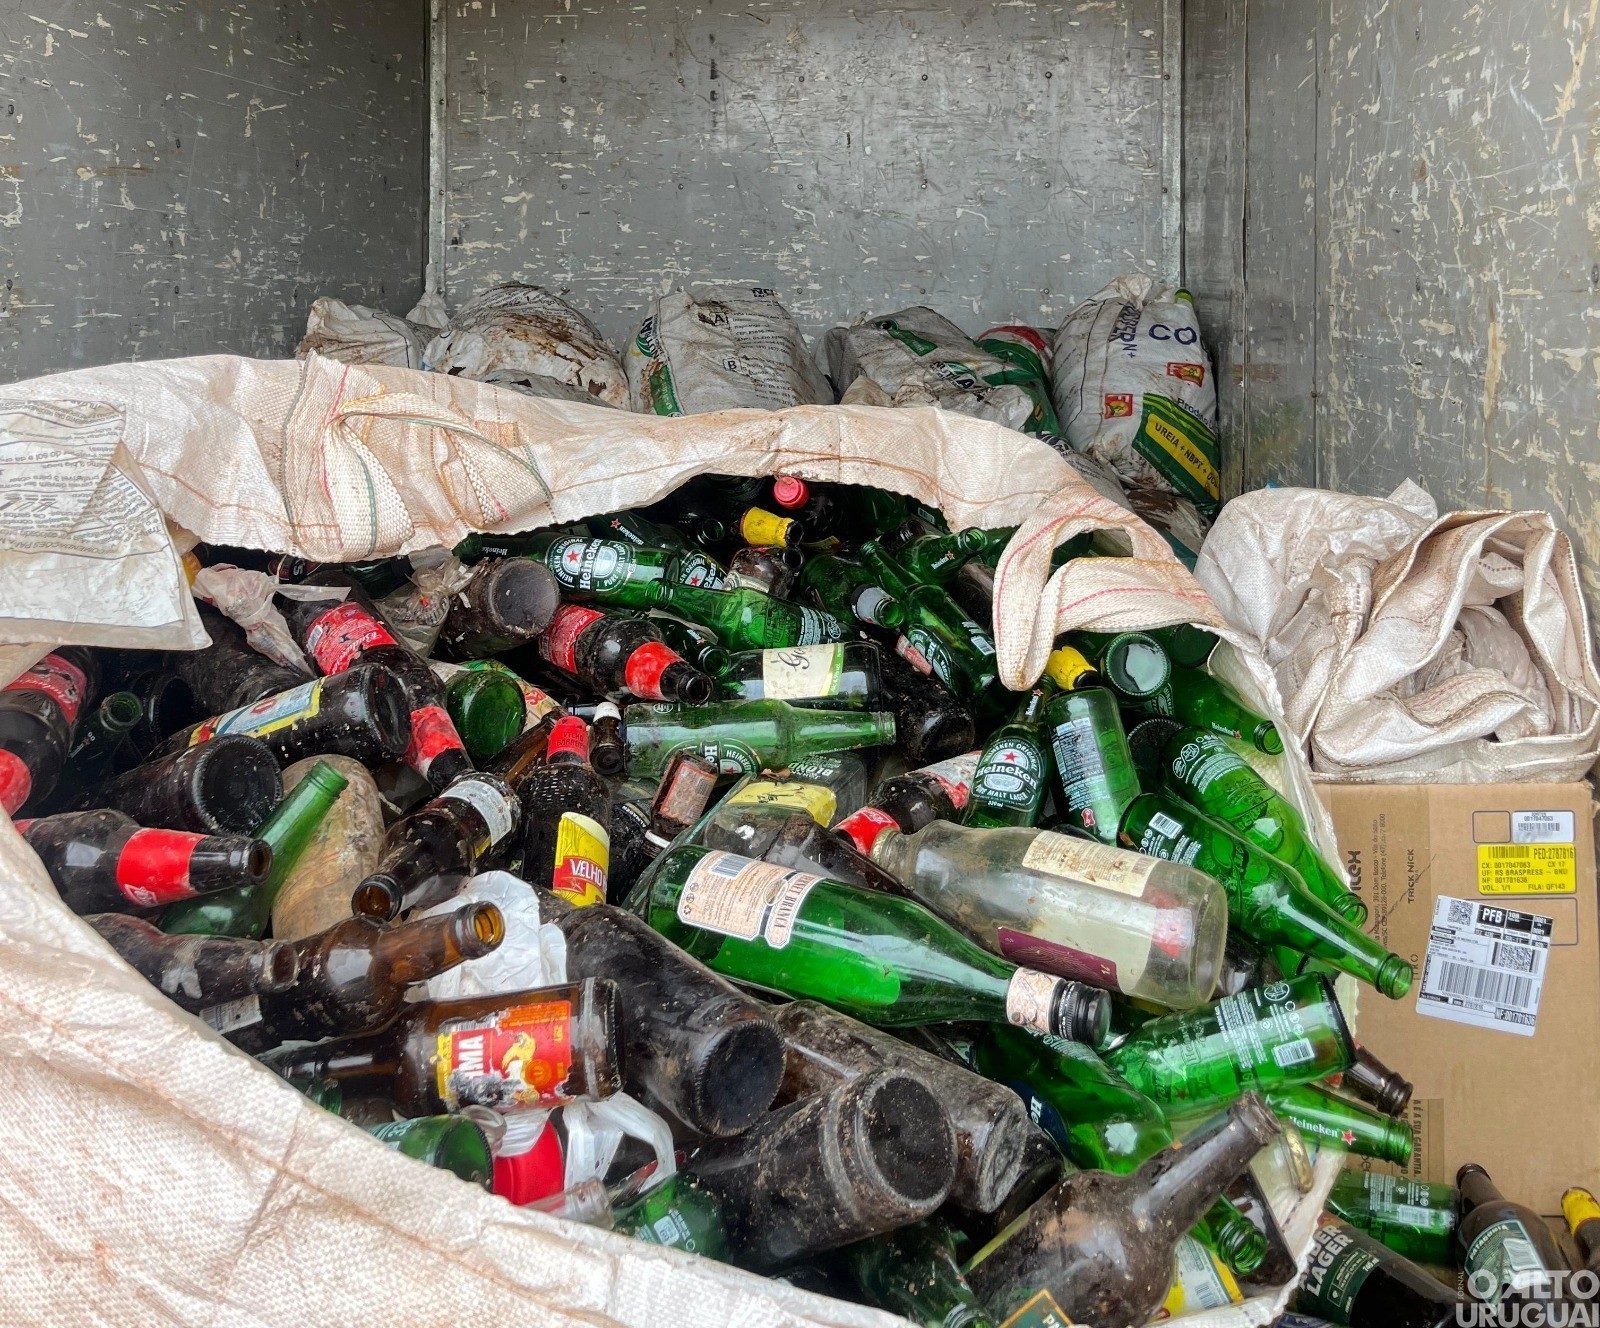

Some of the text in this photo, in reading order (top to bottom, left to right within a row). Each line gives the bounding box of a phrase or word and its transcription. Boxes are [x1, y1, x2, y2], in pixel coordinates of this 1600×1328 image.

[1154, 422, 1181, 447] UREIA
[1184, 449, 1204, 469] NBPT
[579, 539, 604, 590] Heineken
[975, 764, 1037, 790] Heineken
[570, 858, 604, 887] VELHO
[1406, 849, 1415, 904] TRICK NICK
[1481, 907, 1503, 922] PFB
[1413, 1121, 1422, 1135] SUA
[1307, 1234, 1354, 1297] LAGER
